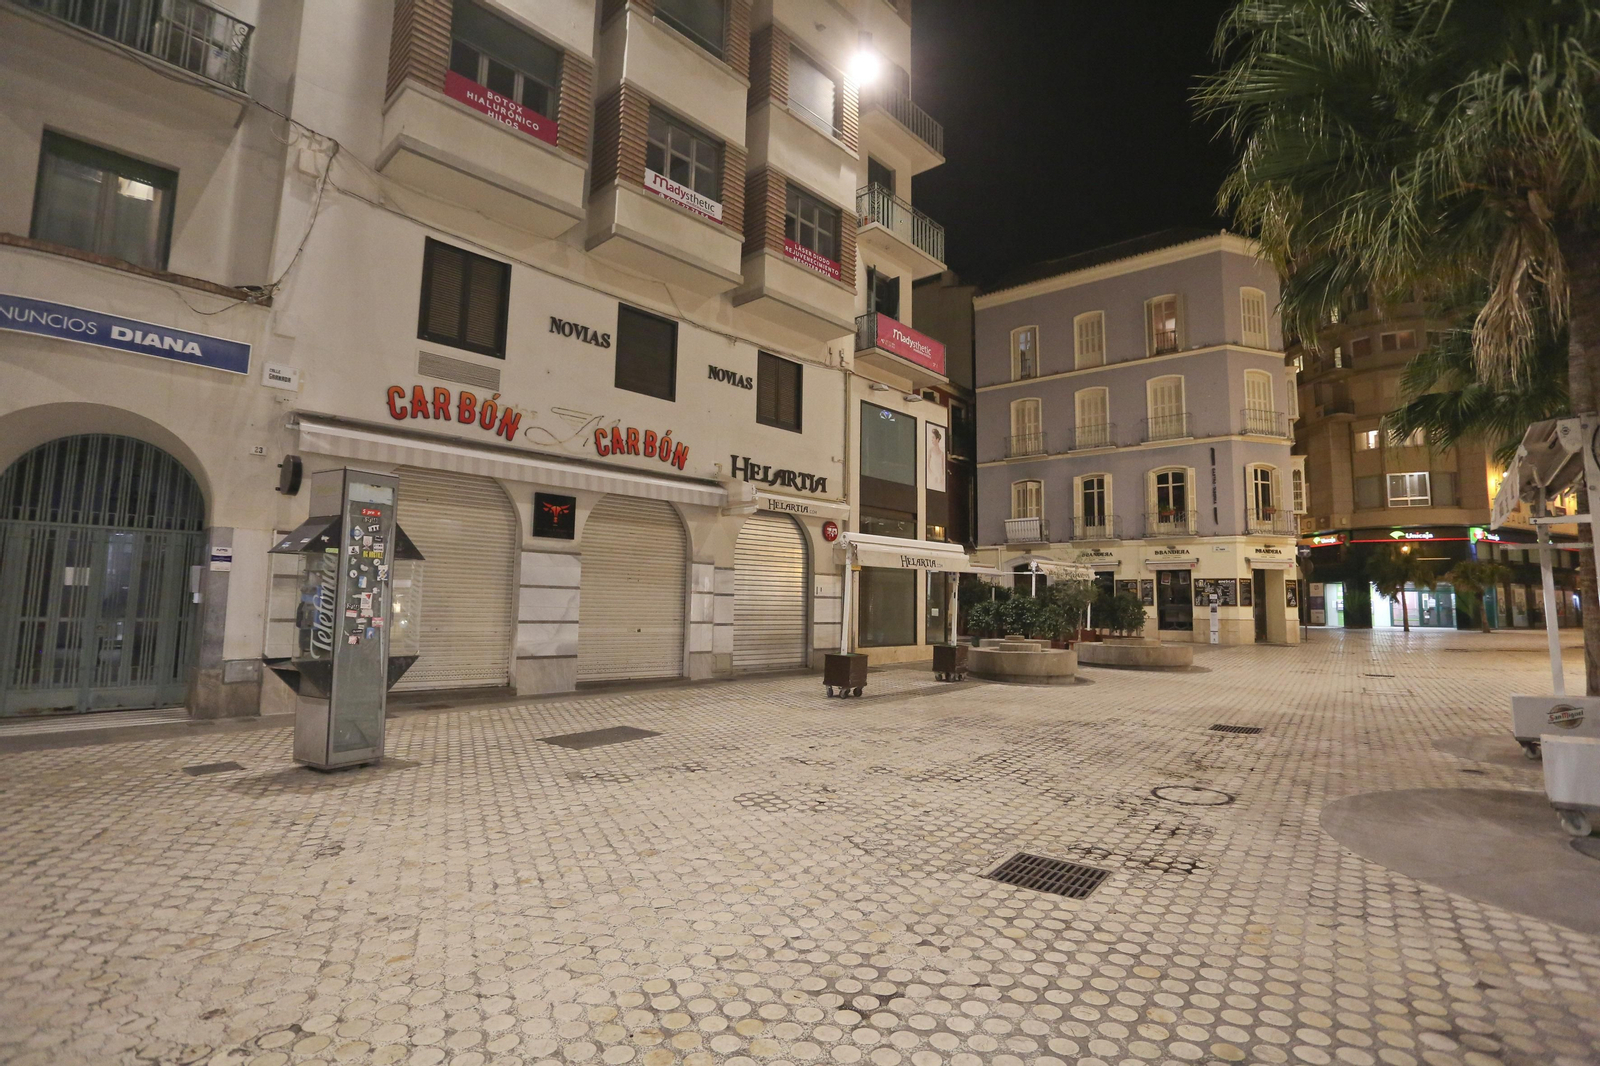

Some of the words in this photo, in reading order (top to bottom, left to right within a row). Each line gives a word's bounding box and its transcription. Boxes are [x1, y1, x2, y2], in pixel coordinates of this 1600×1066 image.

[466, 91, 539, 131] HIALURÓNICO
[487, 91, 523, 114] BOTOX
[487, 110, 519, 130] HILOS
[653, 174, 715, 213] Madysthetic
[785, 245, 839, 276] REJUVENECIMIENTO
[813, 253, 830, 265] DIODO
[110, 325, 202, 357] DIANA
[549, 316, 611, 349] NOVIAS
[708, 364, 753, 391] NOVIAS
[387, 385, 522, 442] CARBÓN
[254, 446, 263, 454] 23
[594, 426, 690, 471] CARBÓN
[730, 454, 828, 494] HELARTIA
[1405, 531, 1434, 540] Unicaja
